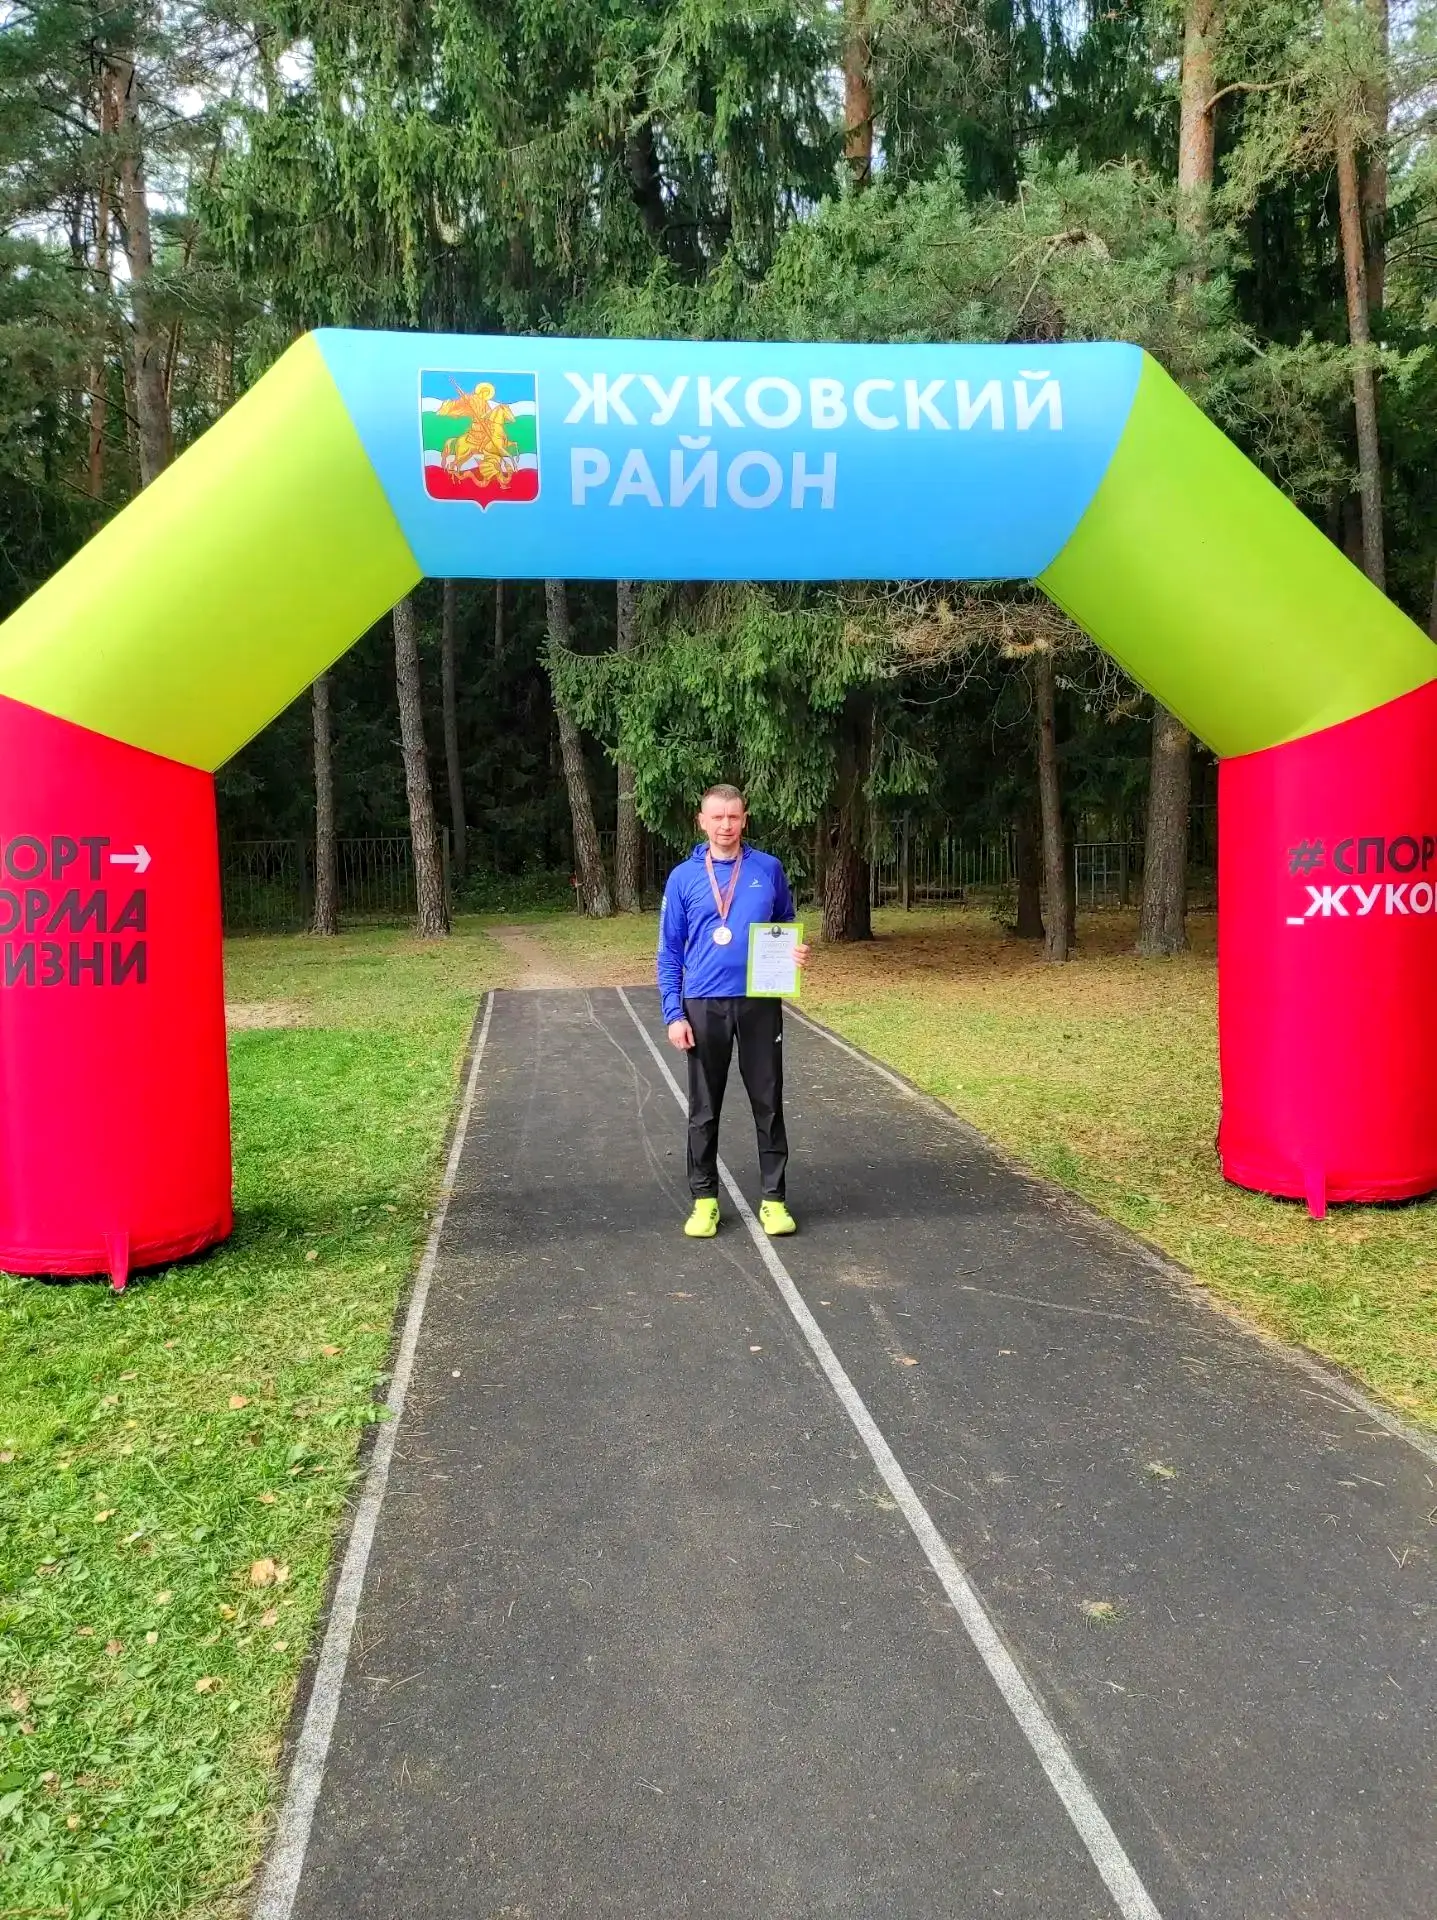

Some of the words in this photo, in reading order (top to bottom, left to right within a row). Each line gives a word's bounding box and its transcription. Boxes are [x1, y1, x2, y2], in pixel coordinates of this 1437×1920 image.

[563, 370, 1063, 431] ЖУКОВСКИЙ
[570, 434, 837, 510] РАЙОН
[0, 835, 111, 881] ОРТ
[1288, 835, 1437, 876] #СПОР
[1286, 881, 1437, 925] _ЖУКО
[0, 940, 147, 987] ИЗНИ
